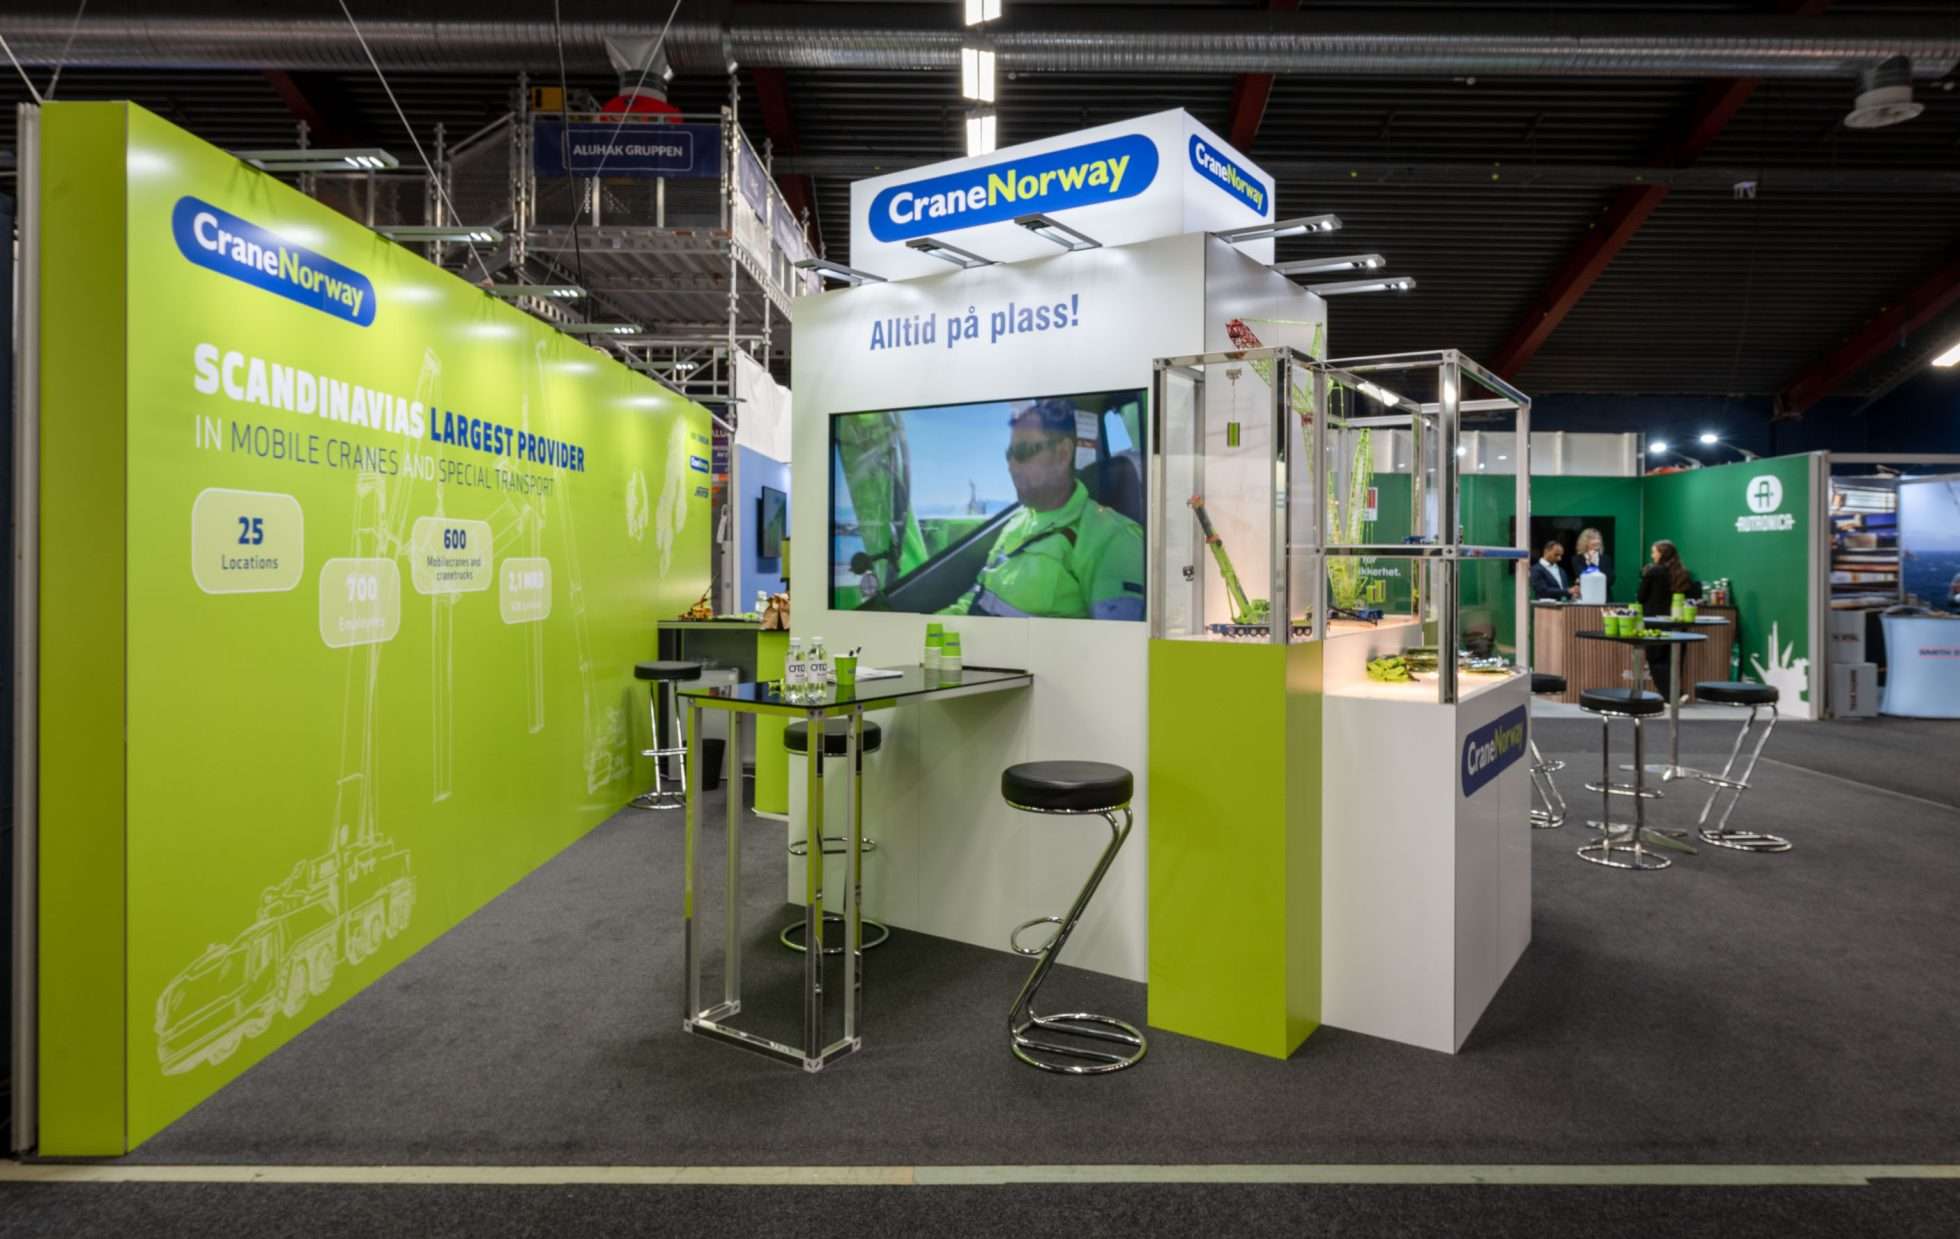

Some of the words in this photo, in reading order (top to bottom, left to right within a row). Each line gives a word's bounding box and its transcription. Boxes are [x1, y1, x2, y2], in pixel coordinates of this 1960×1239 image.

[573, 144, 623, 156] ALUHAK
[625, 145, 683, 157] GRUPPEN
[1195, 142, 1263, 211] CraneNorway
[888, 154, 1131, 225] CraneNorway
[193, 211, 364, 317] CraneNorway
[870, 312, 936, 351] Alltid
[947, 306, 979, 349] på
[990, 293, 1079, 344] plass!
[194, 342, 425, 439] SCANDINAVIAS
[430, 407, 514, 457] LARGEST
[518, 431, 586, 473] PROVIDER
[195, 414, 222, 451] IN
[230, 421, 320, 464] MOBILE
[326, 438, 399, 477] CRANES
[403, 452, 434, 481] AND
[439, 459, 492, 489] SPECIAL
[495, 468, 555, 497] TRANSPORT
[238, 516, 264, 545] 25
[444, 529, 467, 550] 600
[221, 554, 279, 570] Locations
[346, 575, 378, 601] 700
